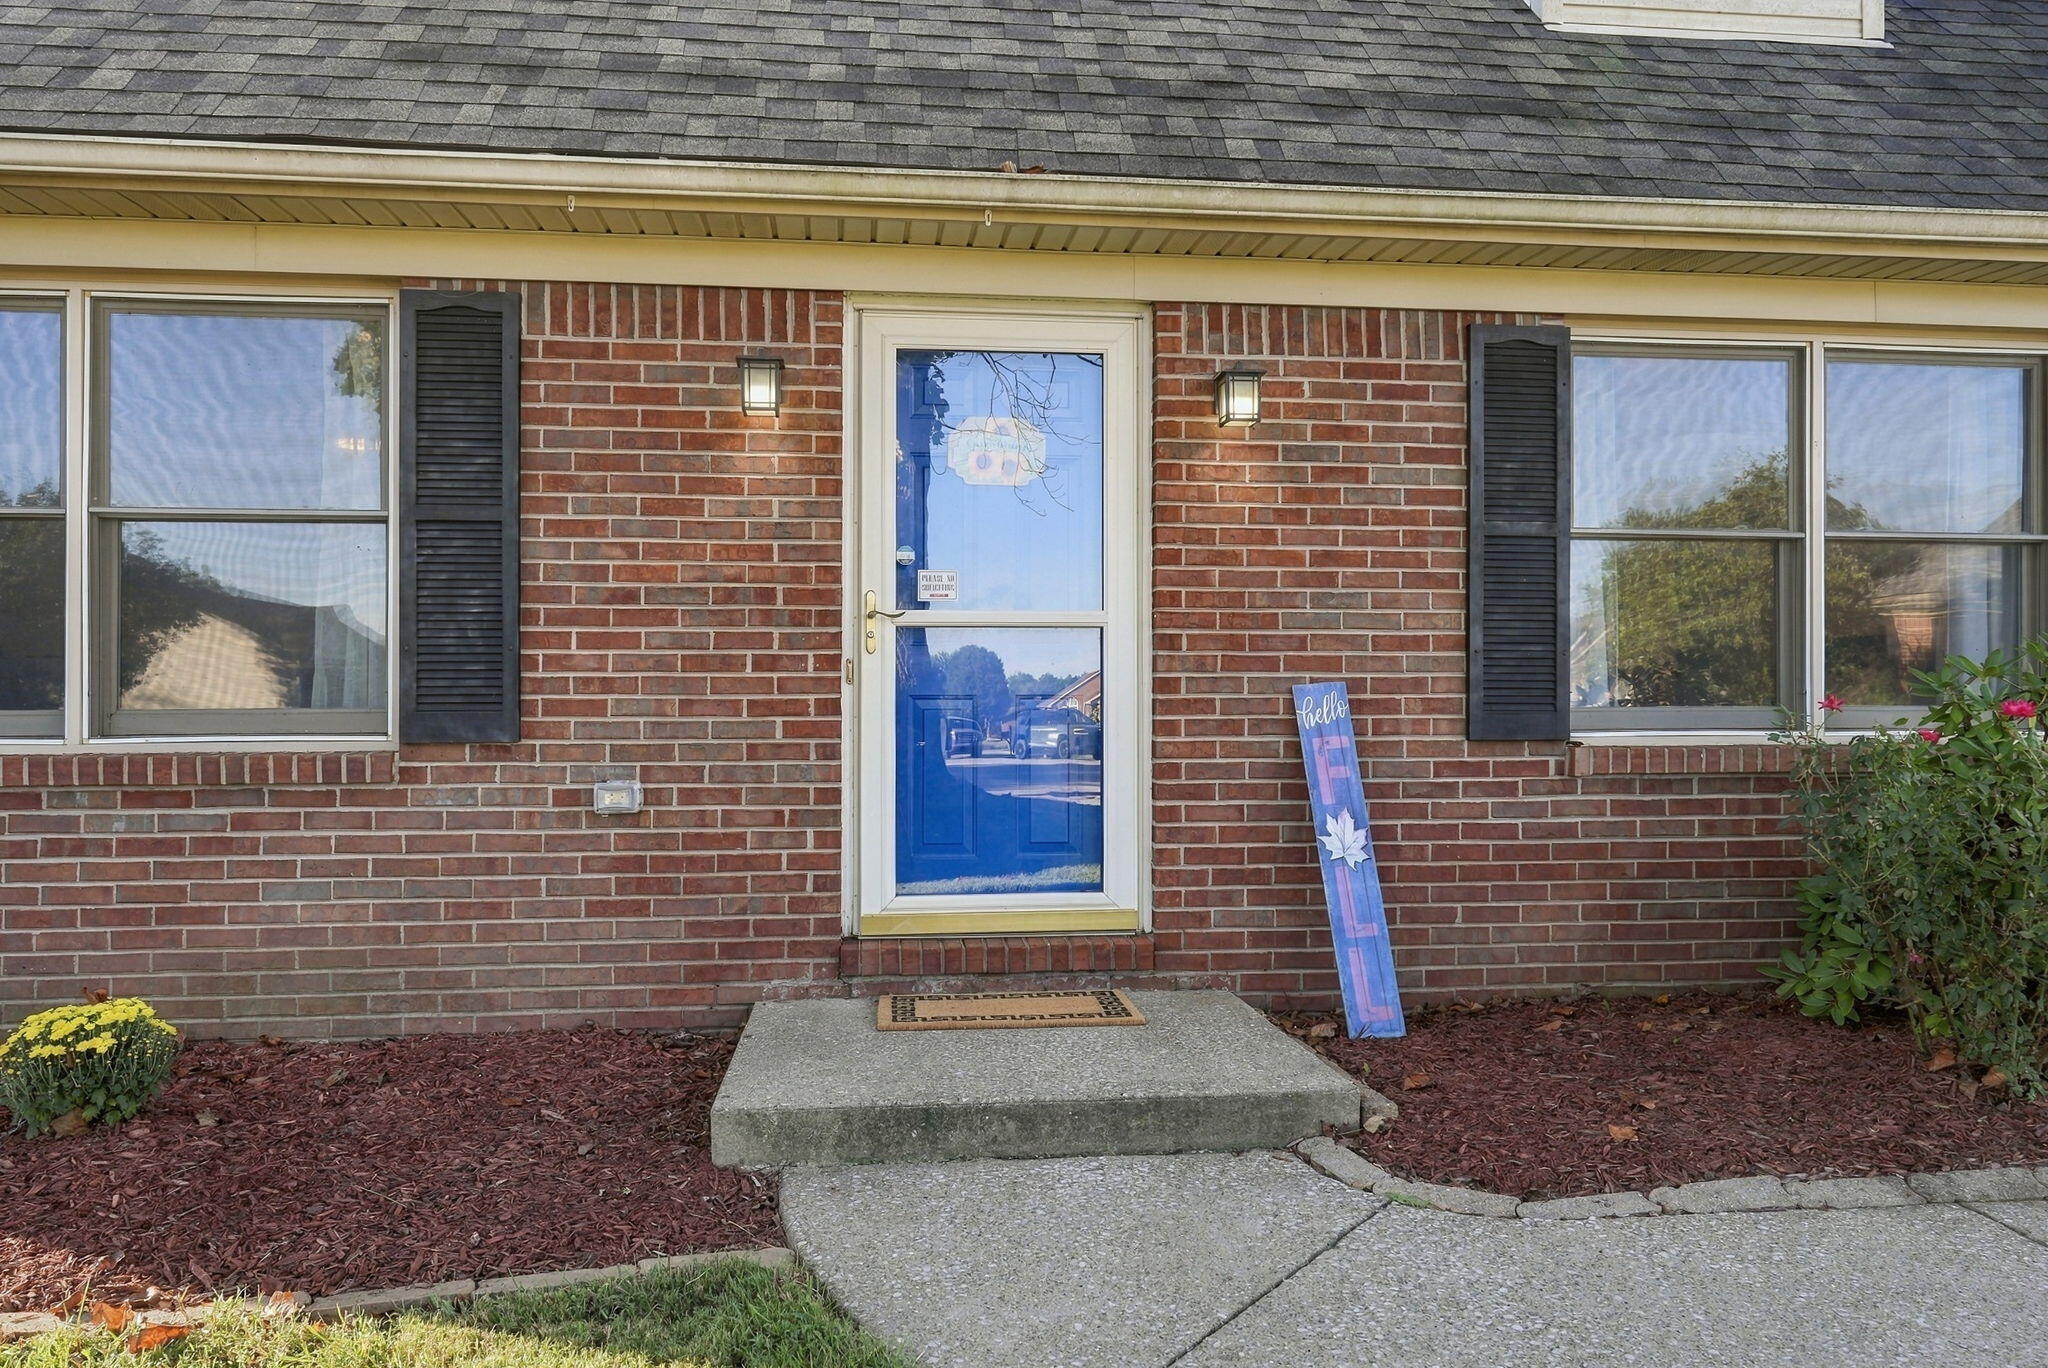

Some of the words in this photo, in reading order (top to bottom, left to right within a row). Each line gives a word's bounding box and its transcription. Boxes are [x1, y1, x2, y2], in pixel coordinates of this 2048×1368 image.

[921, 574, 944, 583] PLEASE
[946, 574, 955, 583] NO
[921, 583, 955, 592] SOLICITING
[1297, 690, 1349, 729] hello
